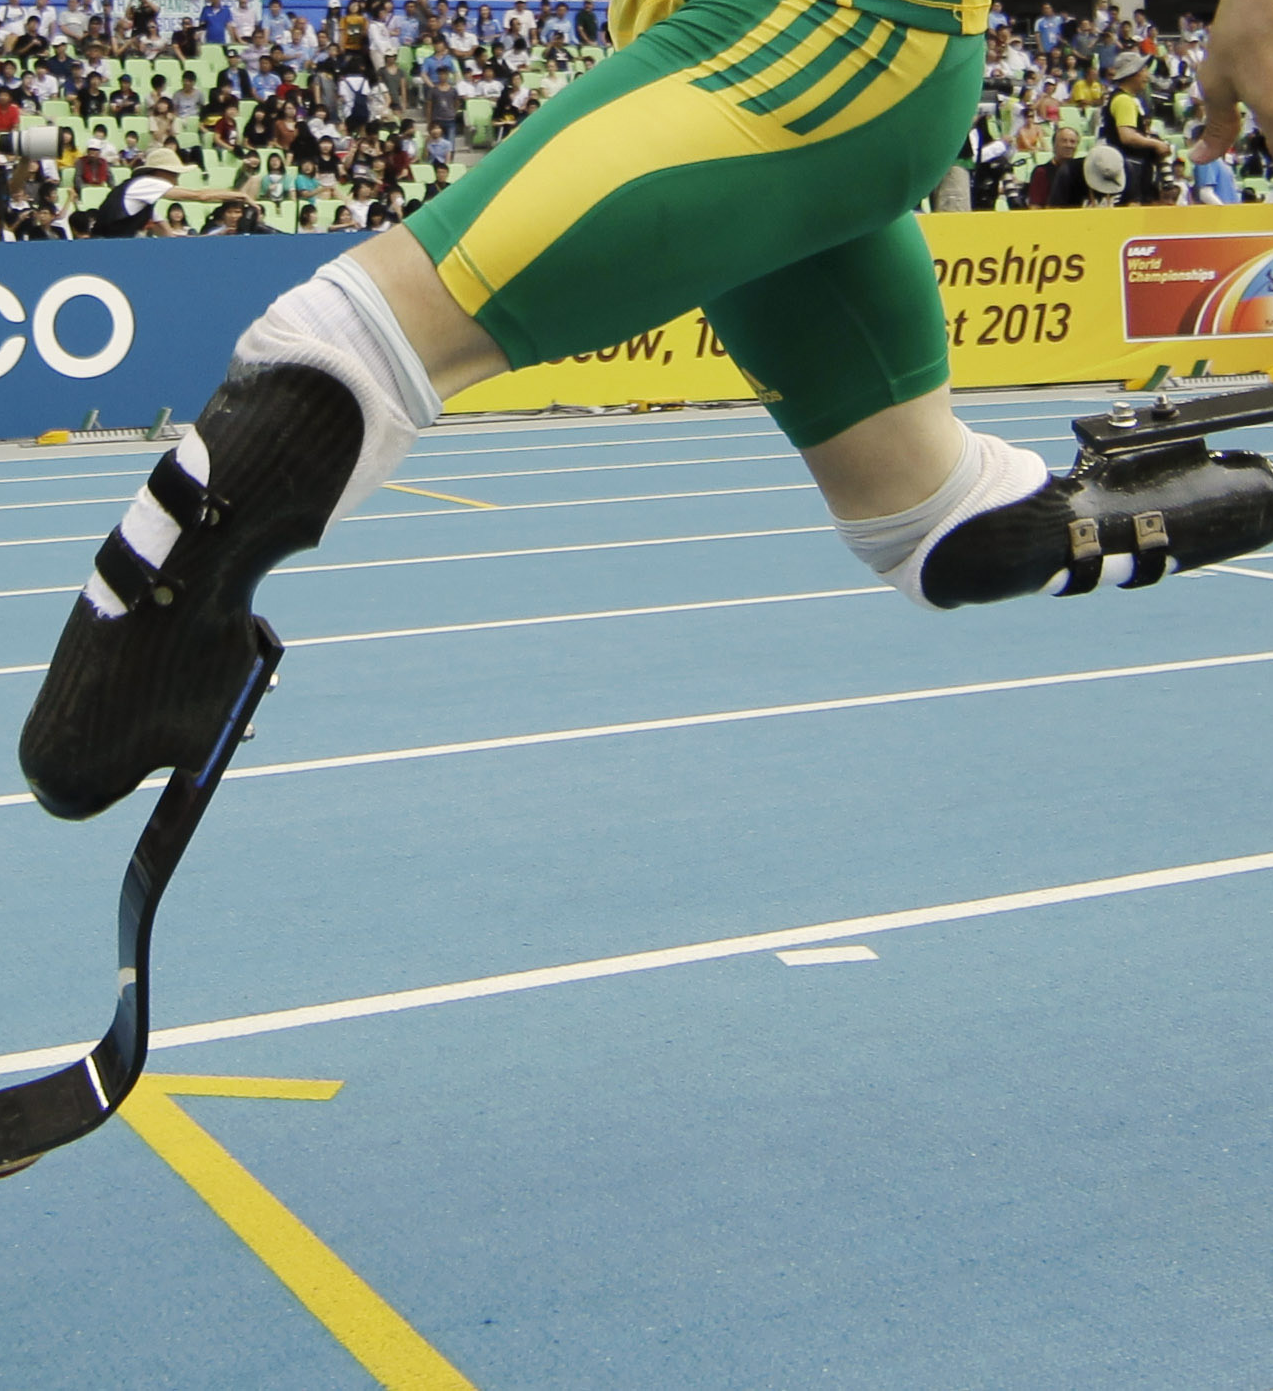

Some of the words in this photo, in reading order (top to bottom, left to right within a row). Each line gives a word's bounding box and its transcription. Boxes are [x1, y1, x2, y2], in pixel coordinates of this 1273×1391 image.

[1128, 258, 1163, 271] World
[1128, 269, 1216, 285] Championships
[976, 302, 1072, 346] 2013
